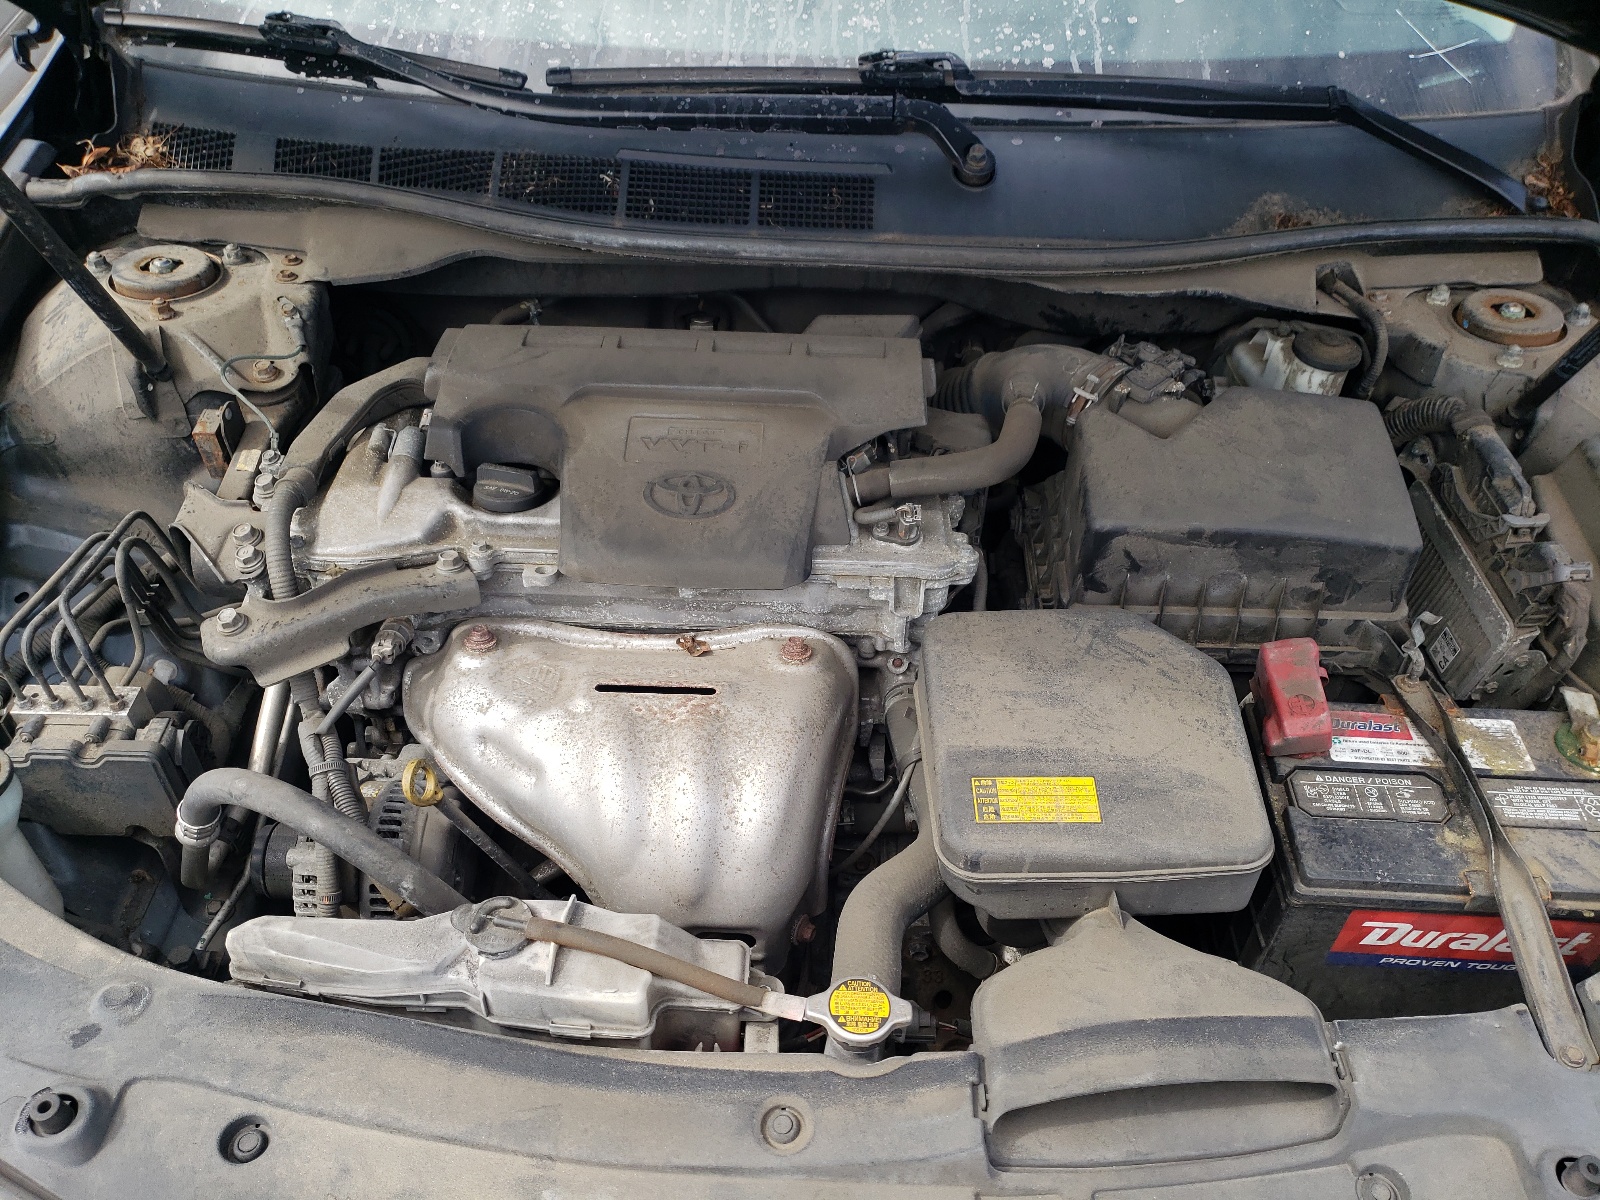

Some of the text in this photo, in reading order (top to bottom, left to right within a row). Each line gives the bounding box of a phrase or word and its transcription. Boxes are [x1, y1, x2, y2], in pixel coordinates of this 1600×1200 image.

[1438, 655, 1450, 670] CA
[1332, 718, 1401, 733] Duralast
[1325, 775, 1366, 784] DANGER
[1375, 777, 1412, 786] POISON
[1358, 921, 1594, 956] Duralt
[1379, 957, 1517, 972] PROVEN TOUG
